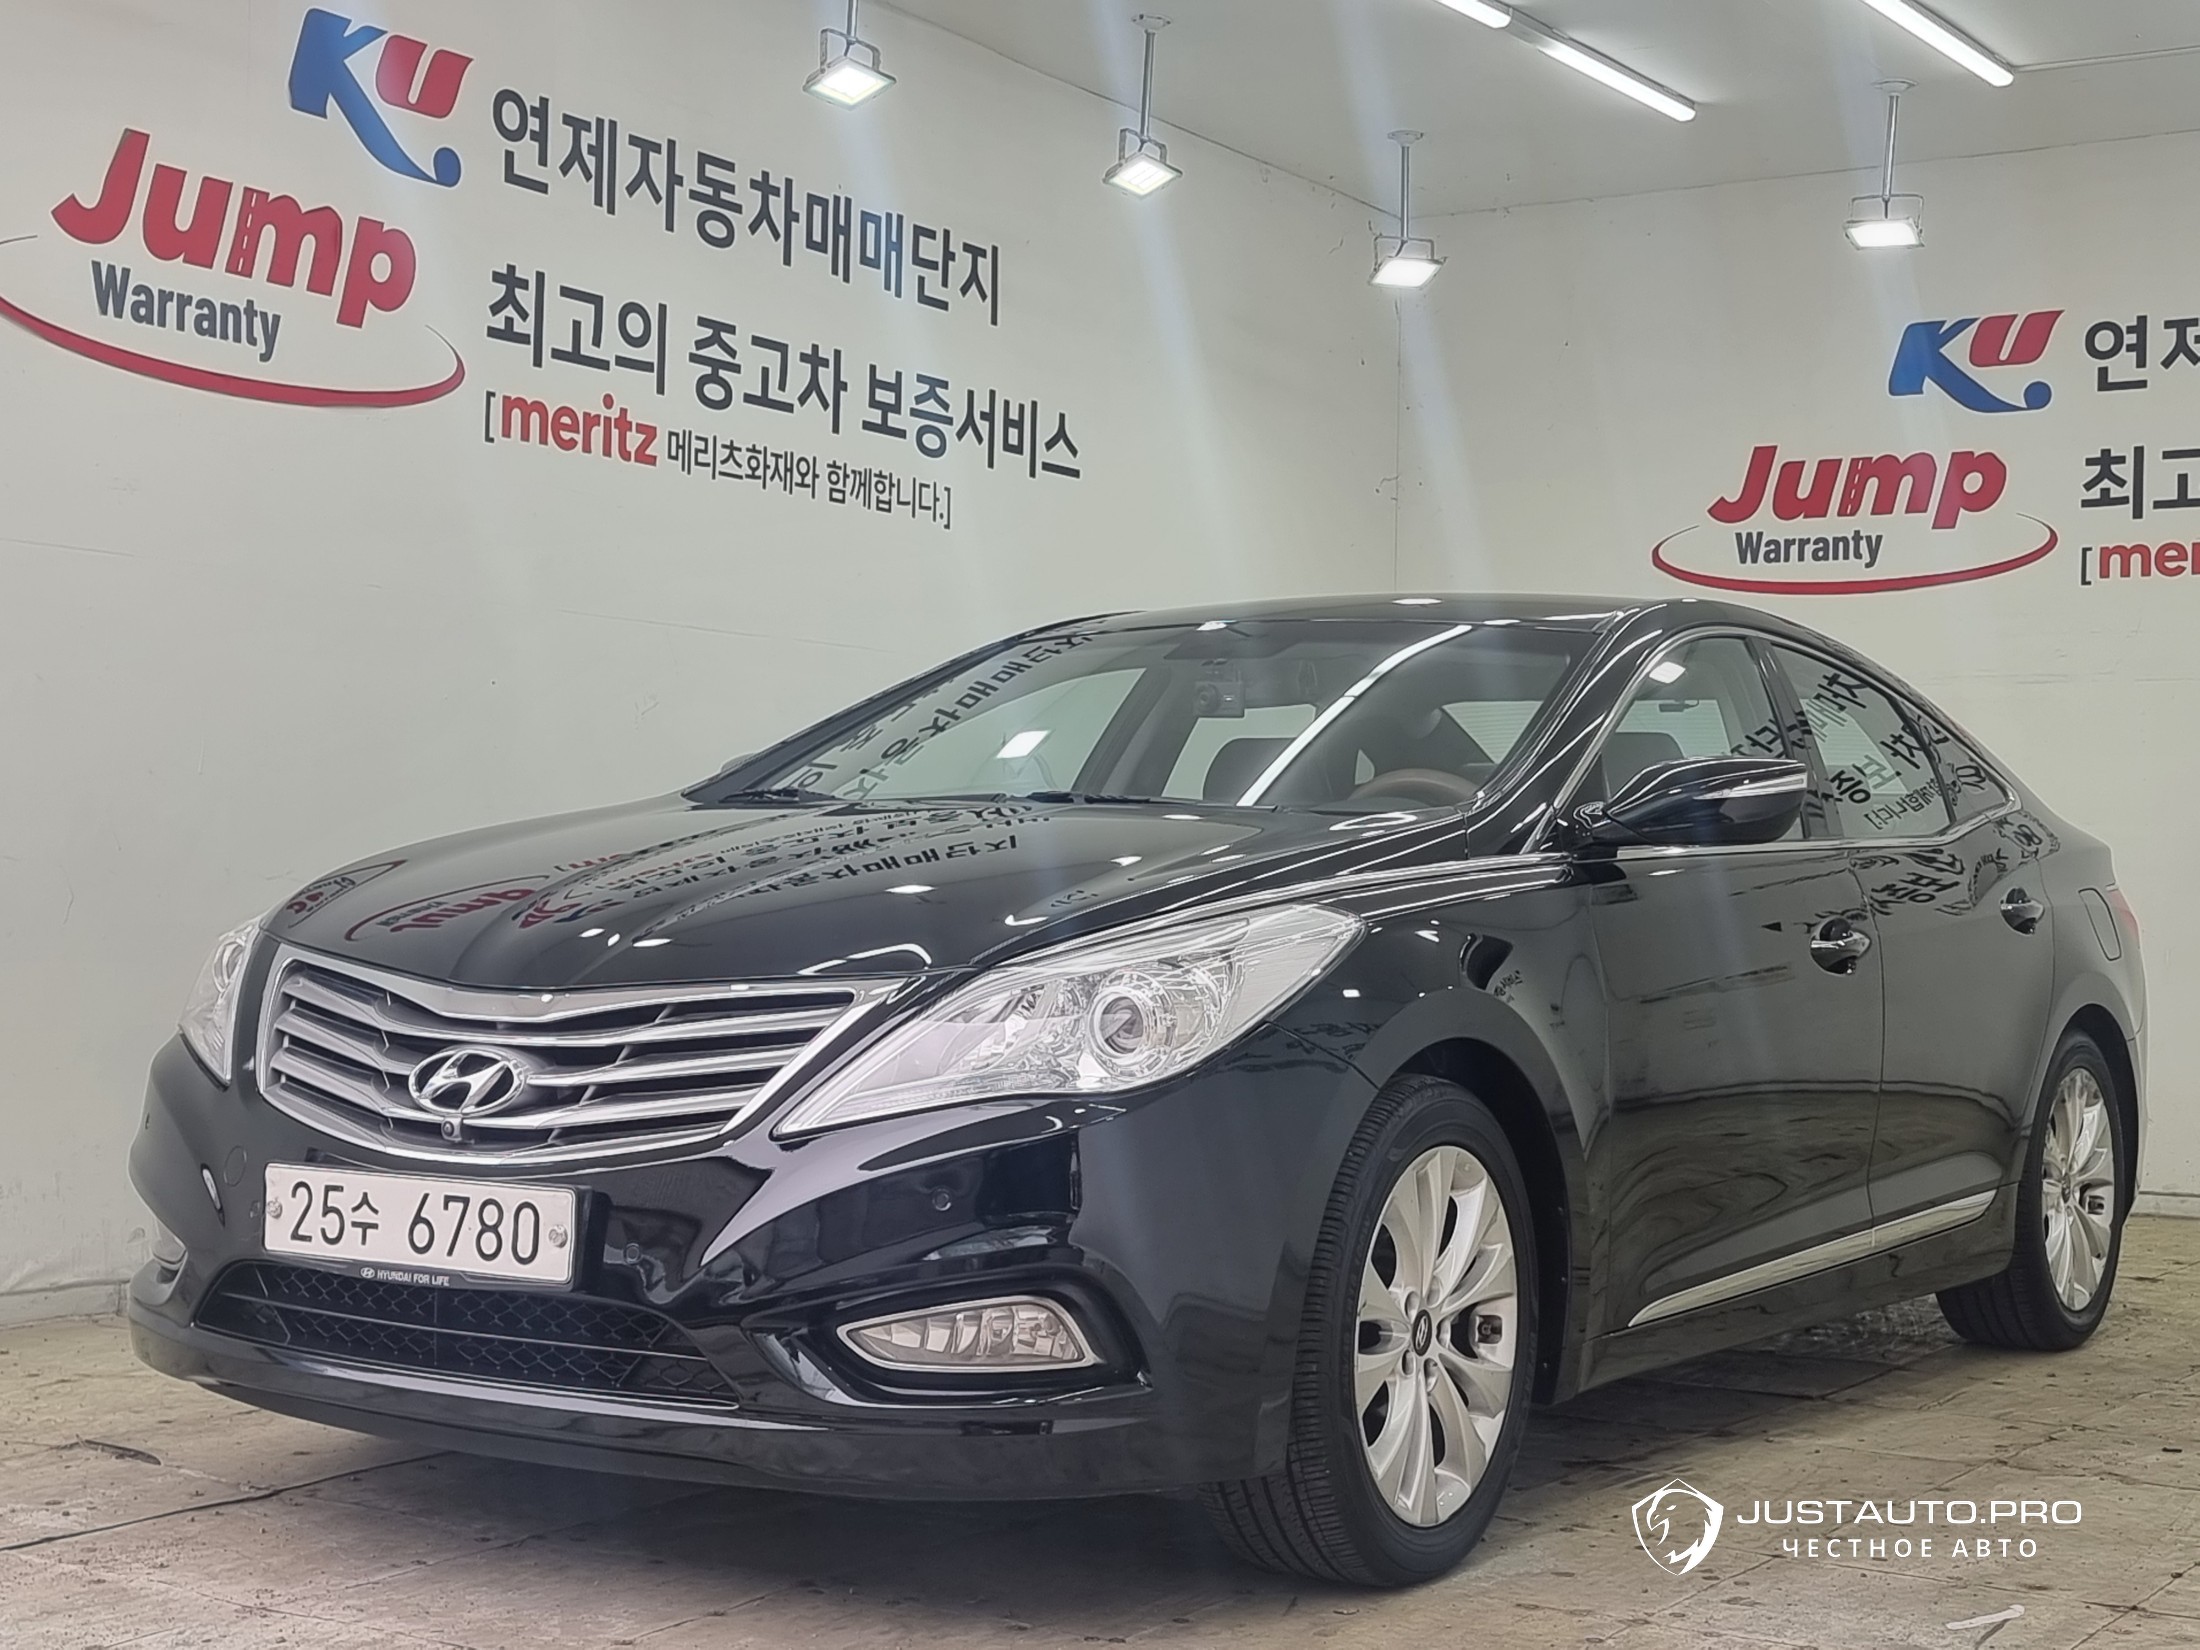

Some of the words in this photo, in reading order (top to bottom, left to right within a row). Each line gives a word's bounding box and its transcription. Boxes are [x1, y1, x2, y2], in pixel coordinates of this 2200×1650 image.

[50, 127, 417, 329] Jump
[491, 88, 999, 327] 연제자동차매매단지
[90, 260, 282, 363] Warranty
[484, 263, 667, 396] 최고의
[687, 314, 849, 435] 중고차
[860, 363, 1082, 480] 보증서비스
[666, 429, 821, 500] 메리츠화재와
[1706, 444, 2007, 530] Jump
[1734, 529, 1884, 568] Warranty
[289, 1180, 380, 1247] 25수
[407, 1192, 541, 1266] 6780
[377, 1269, 411, 1283] HYUNDAI
[413, 1273, 430, 1284] FOR
[431, 1275, 450, 1286] LIFE
